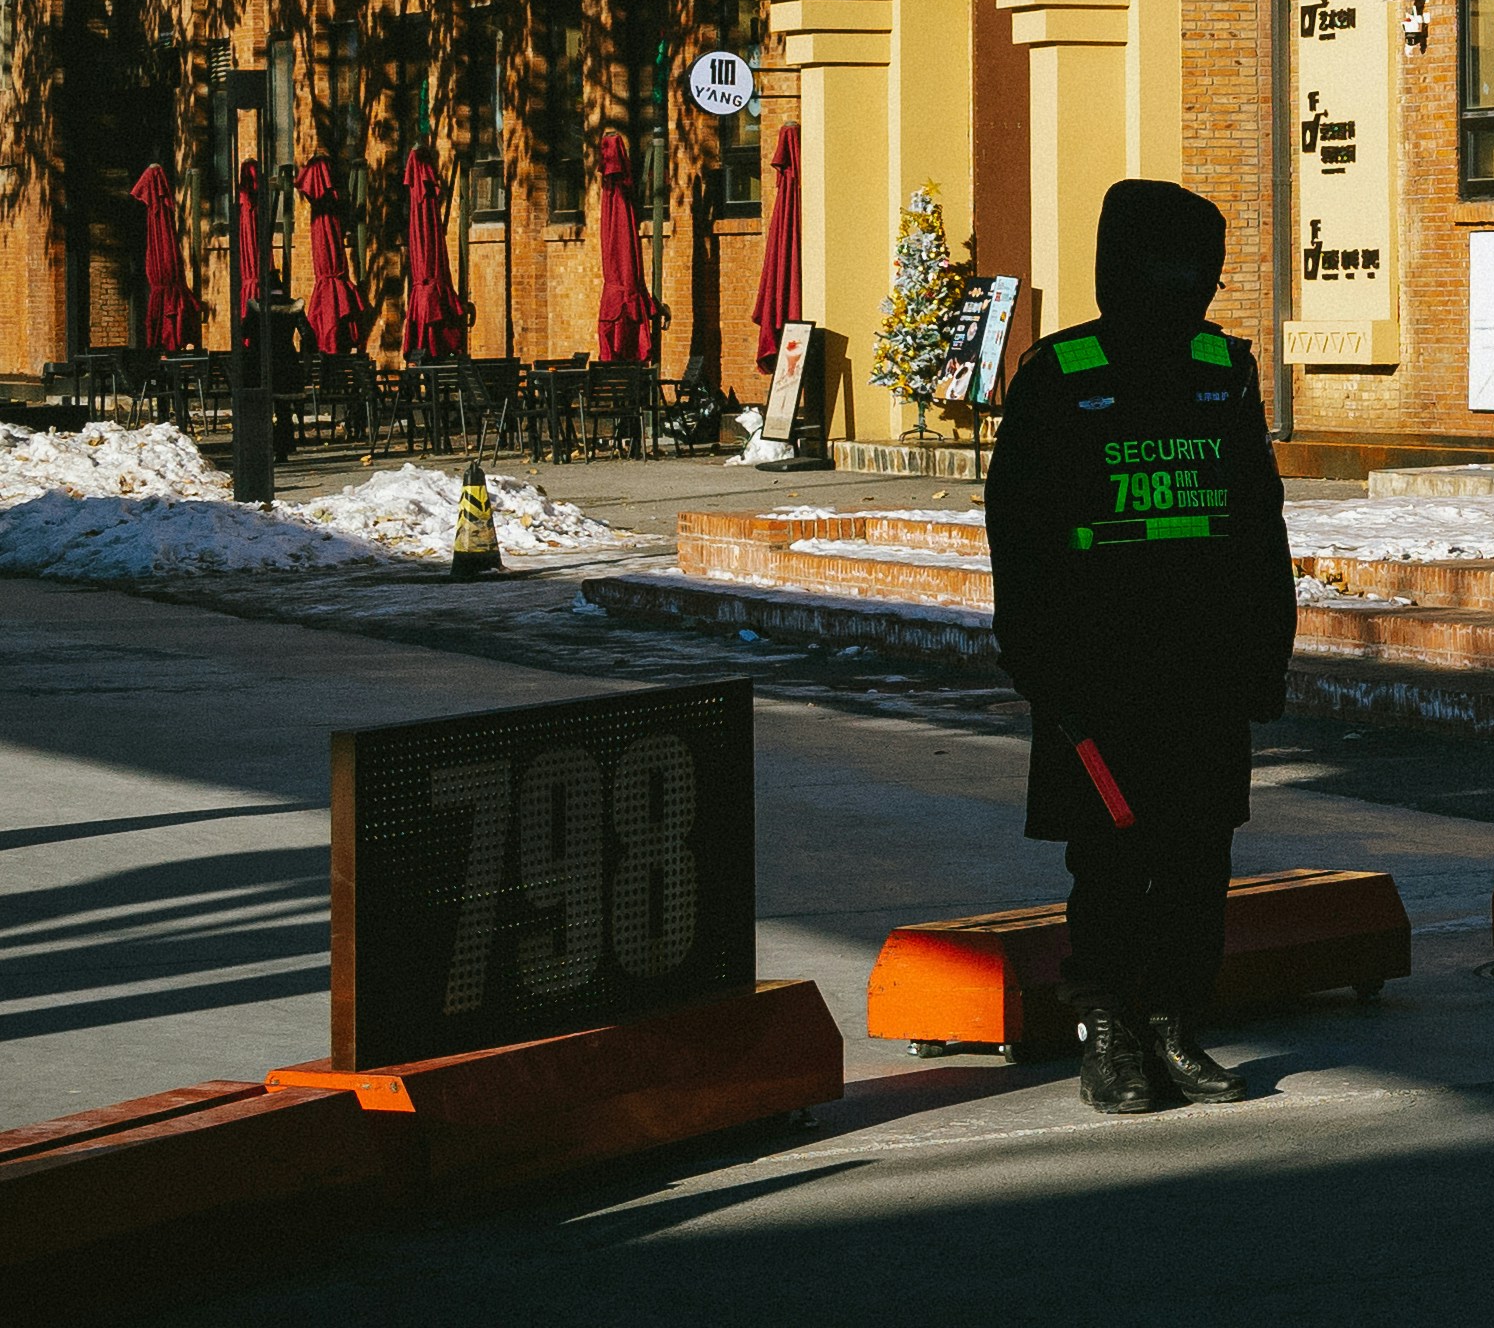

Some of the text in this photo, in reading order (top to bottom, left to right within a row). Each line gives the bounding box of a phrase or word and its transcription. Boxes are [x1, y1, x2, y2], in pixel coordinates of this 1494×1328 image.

[1104, 438, 1222, 465] SECURITY
[1110, 470, 1199, 513] 798 ART
[1177, 488, 1229, 508] DISTRICT
[430, 733, 699, 1017] 798
